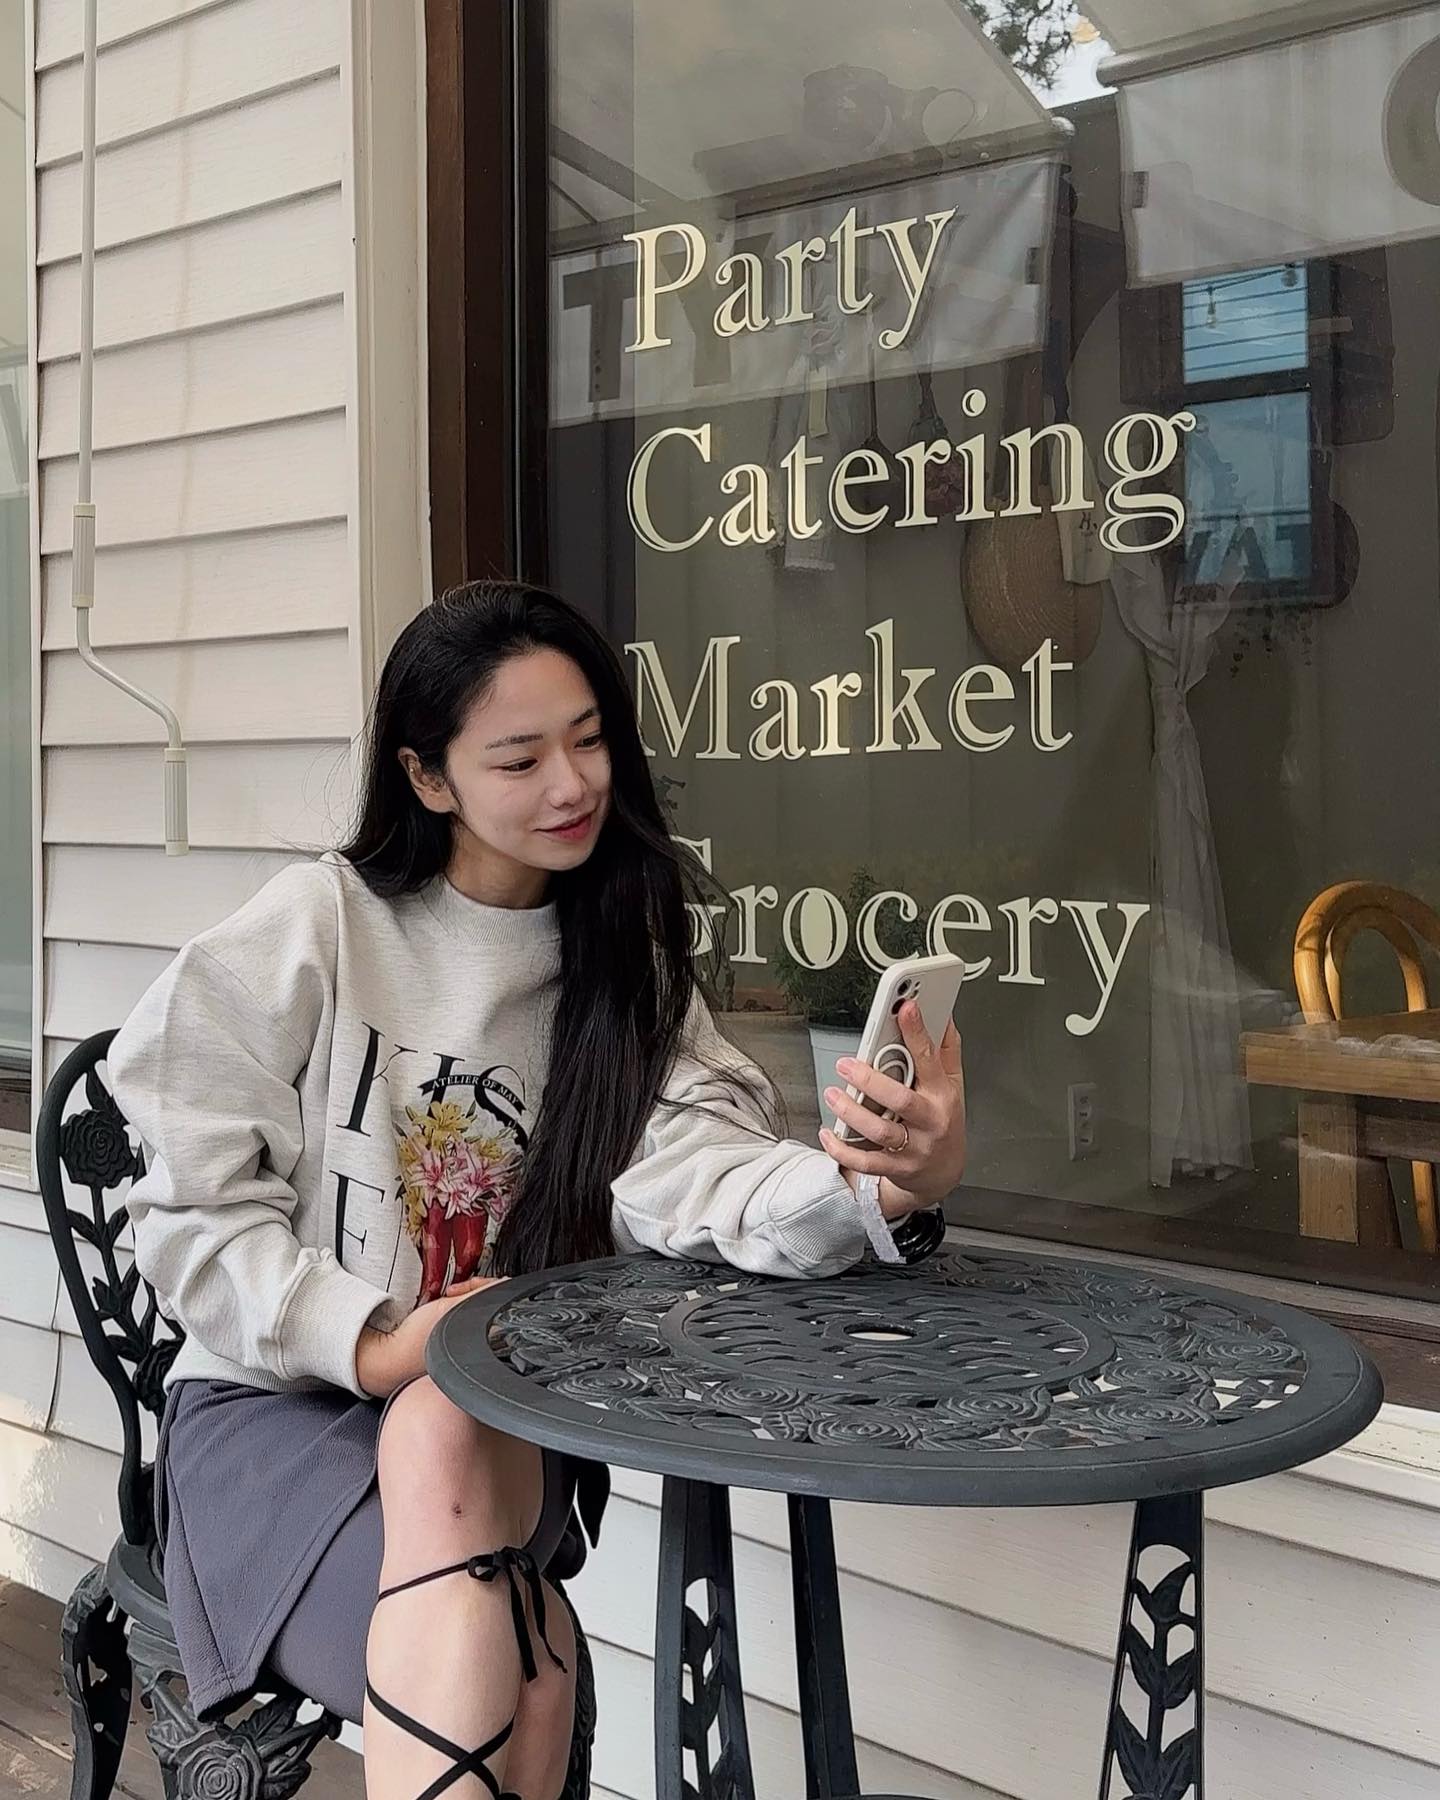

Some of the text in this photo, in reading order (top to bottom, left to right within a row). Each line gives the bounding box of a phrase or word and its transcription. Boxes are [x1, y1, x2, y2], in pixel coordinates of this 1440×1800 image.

[623, 207, 957, 353] Party
[625, 390, 1198, 555] Catering
[623, 618, 1074, 762] Market
[431, 1075, 520, 1105] ATELIER OF MAY
